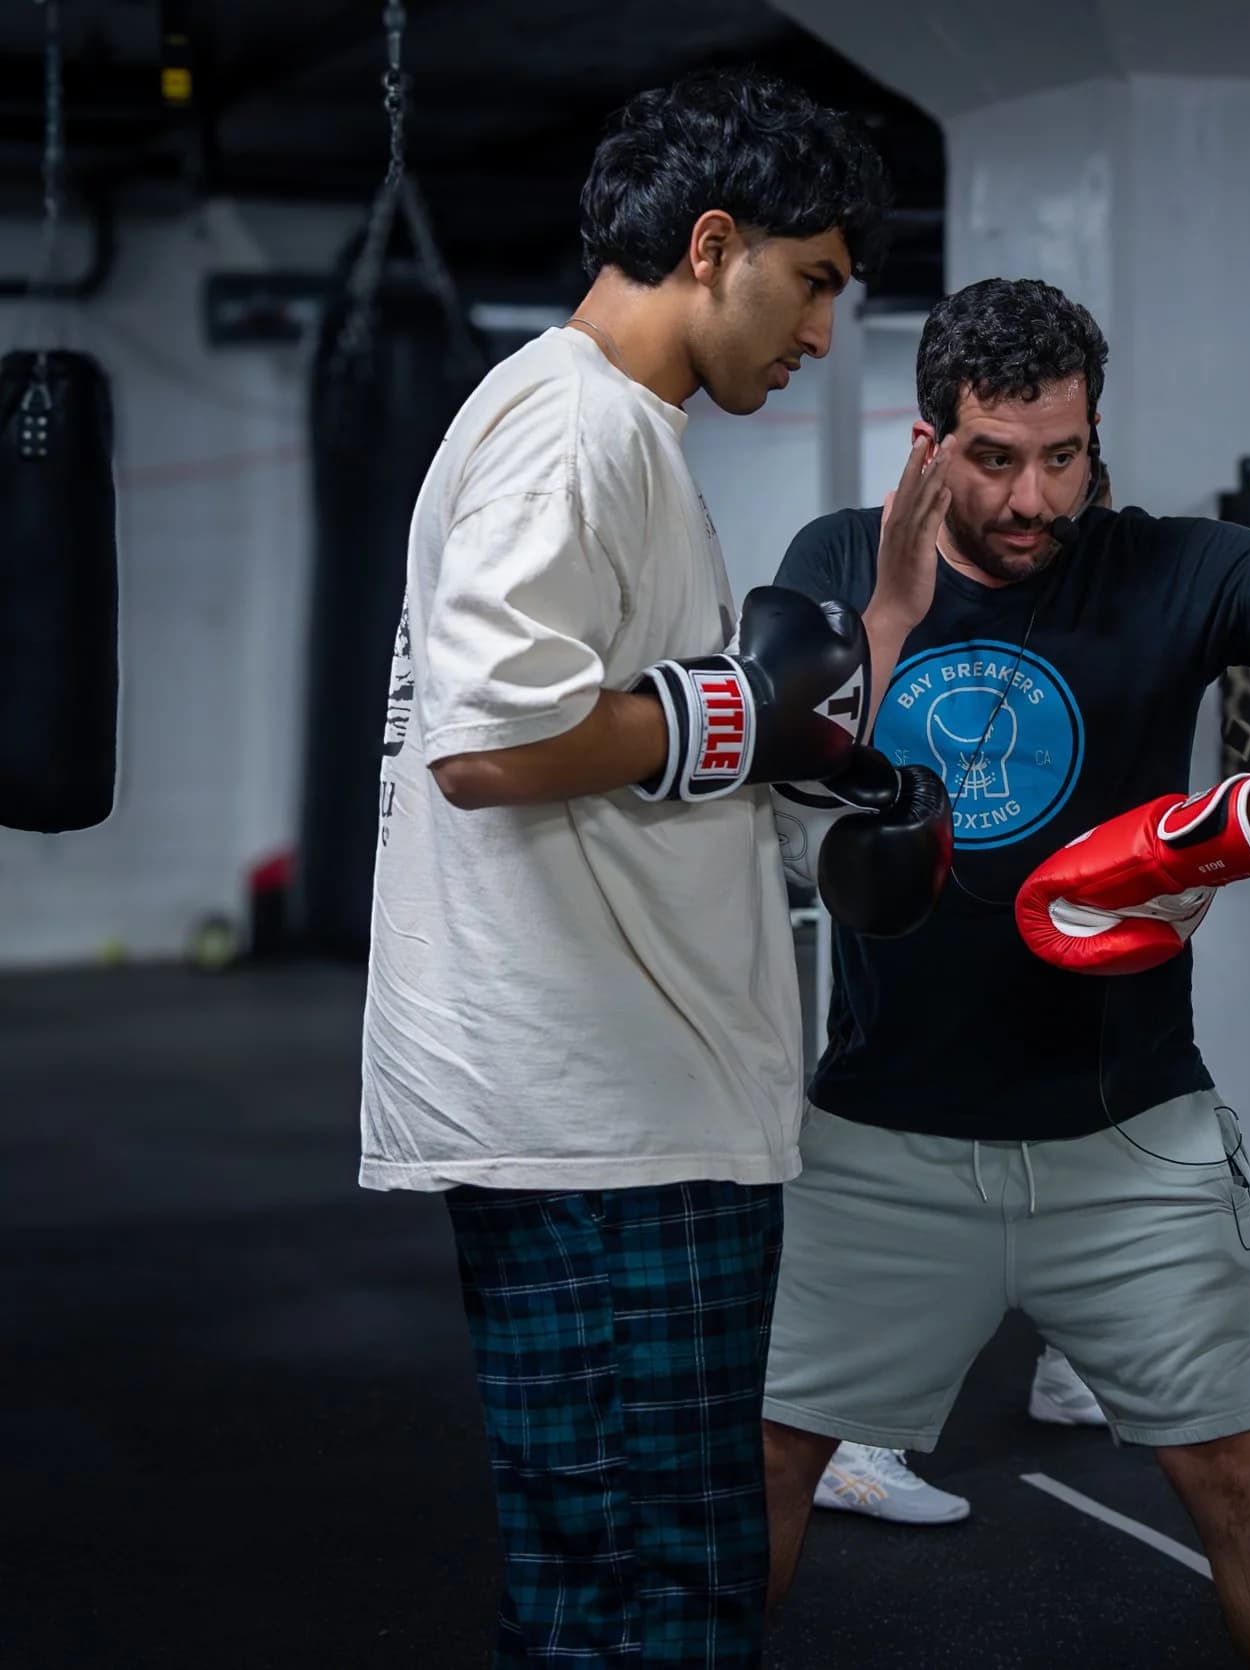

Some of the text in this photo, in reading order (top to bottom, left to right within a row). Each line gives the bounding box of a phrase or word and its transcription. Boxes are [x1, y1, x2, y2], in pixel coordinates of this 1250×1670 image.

[897, 661, 1045, 709] BAY BREAKERS
[700, 678, 744, 770] TITLE
[1035, 750, 1051, 765] CA
[952, 800, 1021, 829] OXING
